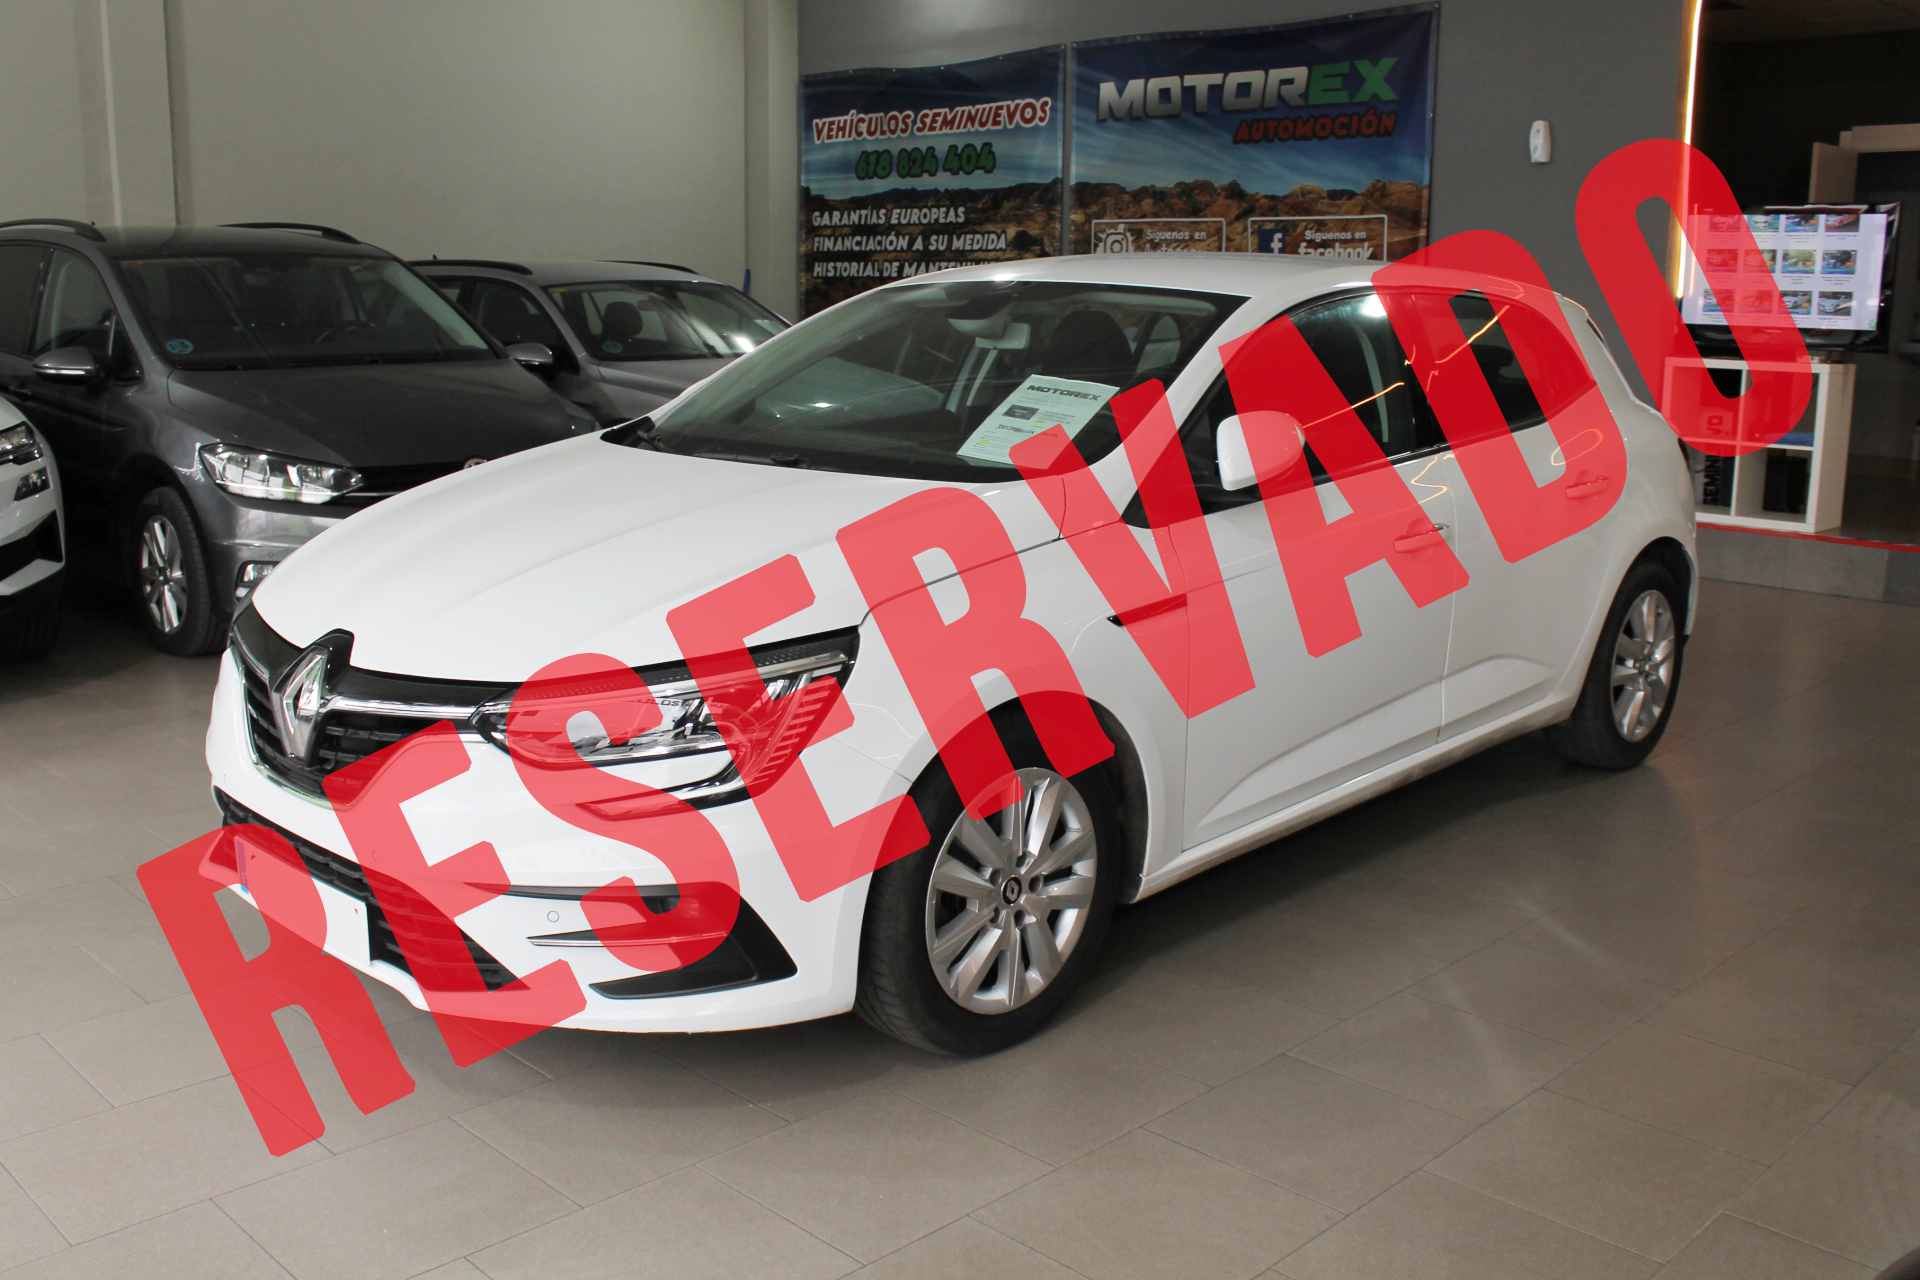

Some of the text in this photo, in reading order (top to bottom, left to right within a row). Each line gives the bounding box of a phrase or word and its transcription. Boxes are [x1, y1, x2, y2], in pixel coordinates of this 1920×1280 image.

[1097, 57, 1398, 122] MOTOREX
[813, 97, 1051, 143] VEHÍCULOS SEMINUEVOS
[1232, 109, 1398, 144] AUTOMOCIÓN
[855, 142, 997, 180] 618 824 404
[812, 206, 965, 226] GARANTÍAS EUROPEAS
[813, 231, 1007, 251] FINANCIACIÓN A SU MEDIDA
[1194, 231, 1207, 240] en
[1354, 231, 1366, 239] en
[813, 261, 880, 277] HISTORIAL
[883, 261, 900, 277] DE
[1027, 385, 1101, 401] MOTOREX
